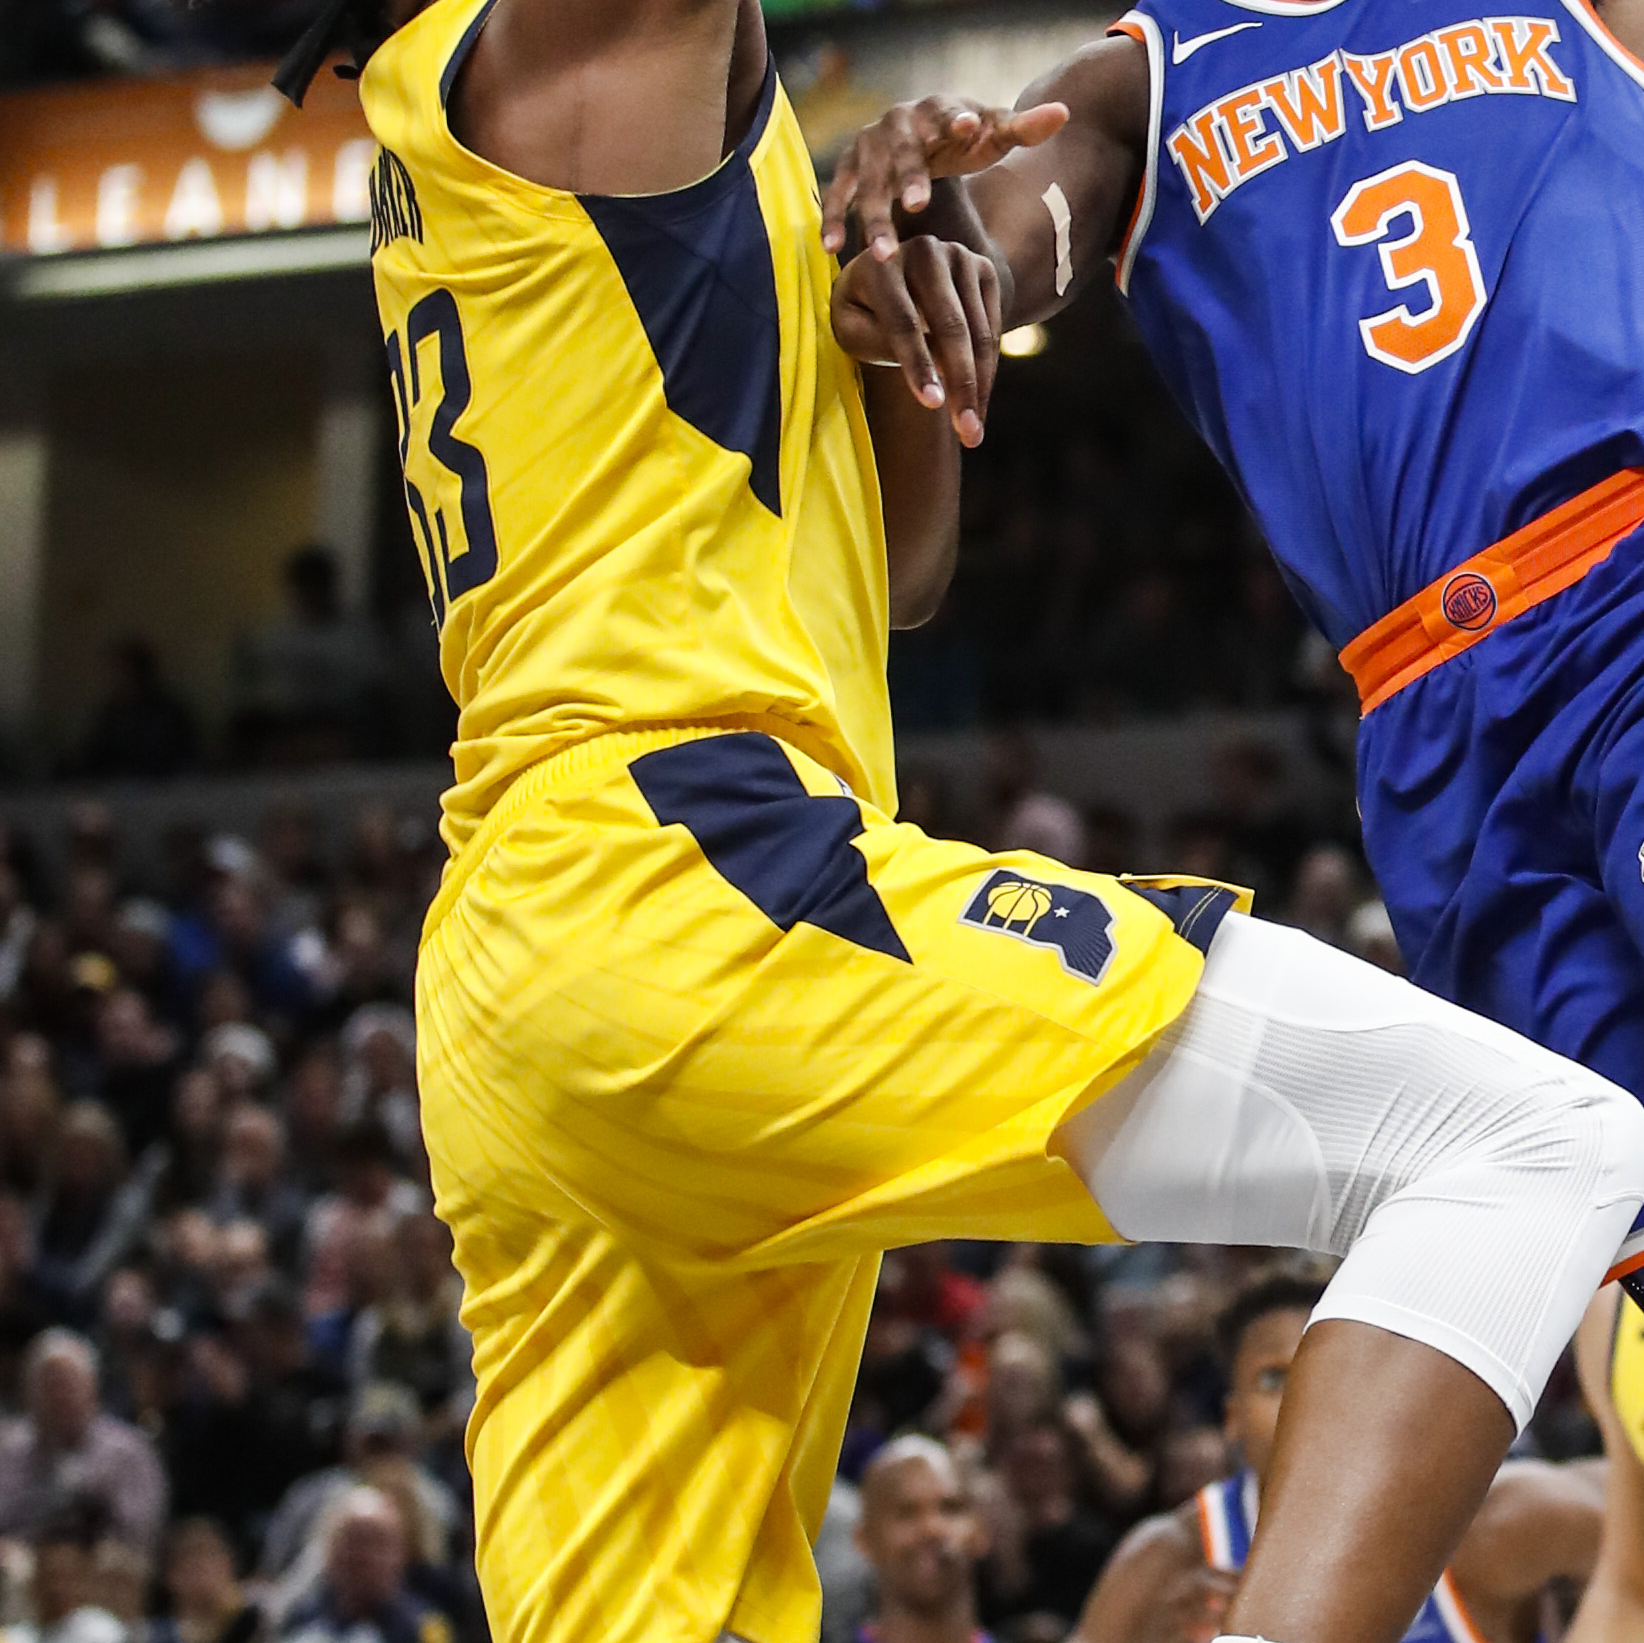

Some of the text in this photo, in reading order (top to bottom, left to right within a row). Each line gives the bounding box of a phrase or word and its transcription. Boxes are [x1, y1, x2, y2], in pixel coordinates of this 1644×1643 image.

[1166, 16, 1577, 226] NEW YORK
[1330, 159, 1488, 375] 3
[1448, 585, 1489, 620] KNICKS
